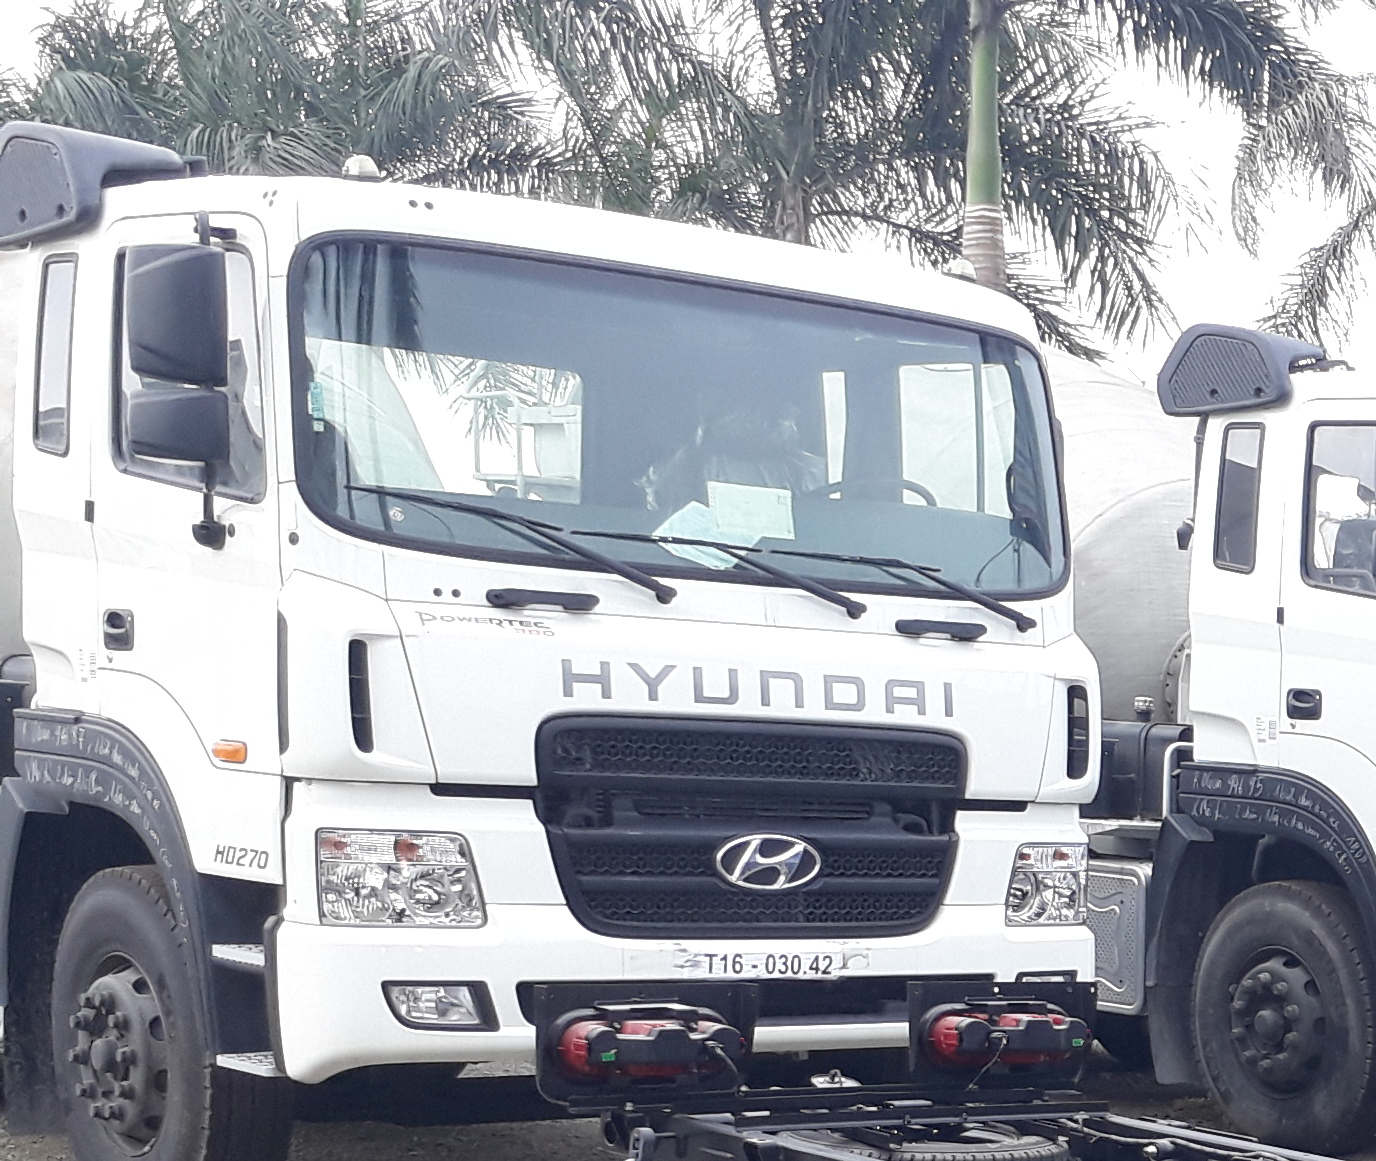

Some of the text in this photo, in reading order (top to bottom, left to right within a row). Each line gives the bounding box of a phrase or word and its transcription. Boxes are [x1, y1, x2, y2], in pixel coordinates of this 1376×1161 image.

[561, 659, 954, 718] HYUNDAI
[213, 844, 270, 870] HD270
[704, 953, 744, 975] T16
[765, 954, 833, 976] 030.42
